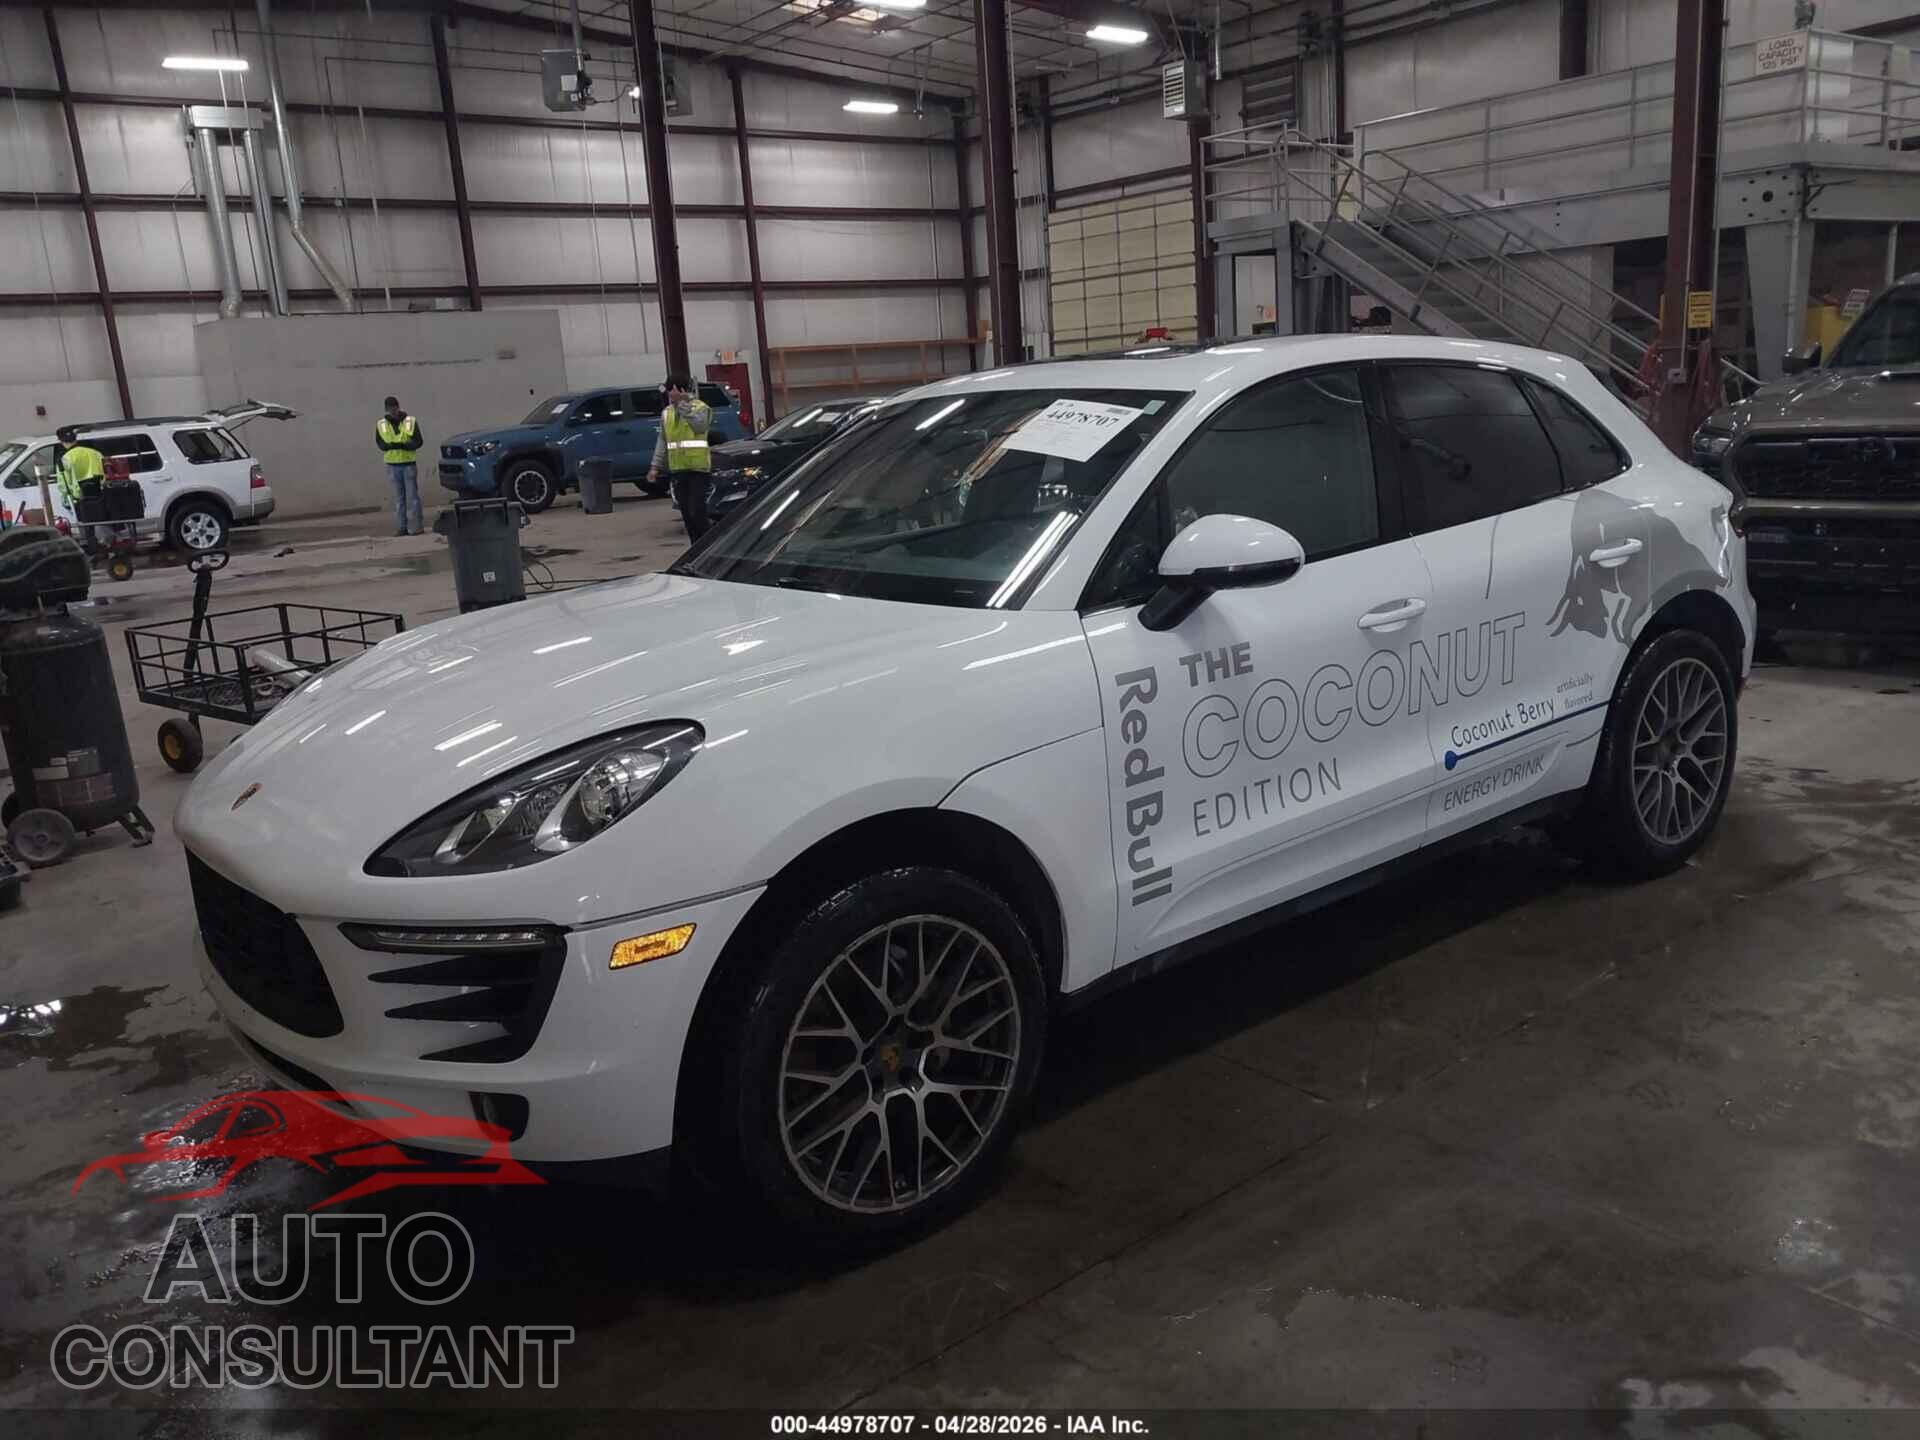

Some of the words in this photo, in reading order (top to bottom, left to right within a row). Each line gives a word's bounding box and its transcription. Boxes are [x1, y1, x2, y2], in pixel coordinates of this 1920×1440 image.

[1759, 46, 1804, 61] CAPACITY
[1769, 39, 1794, 50] LOAD
[1047, 410, 1119, 428] 44978707
[1179, 641, 1254, 688] THE
[1556, 672, 1595, 694] artificially
[1183, 611, 1525, 778] COCONUT
[1564, 690, 1593, 710] flavored
[1115, 666, 1165, 788] Red
[1451, 709, 1515, 748] Coconut
[1517, 697, 1555, 724] Berry
[1193, 757, 1342, 837] EDITION
[1443, 773, 1500, 812] ENERGY
[1502, 751, 1546, 787] DRINK
[1126, 790, 1173, 907] Bull
